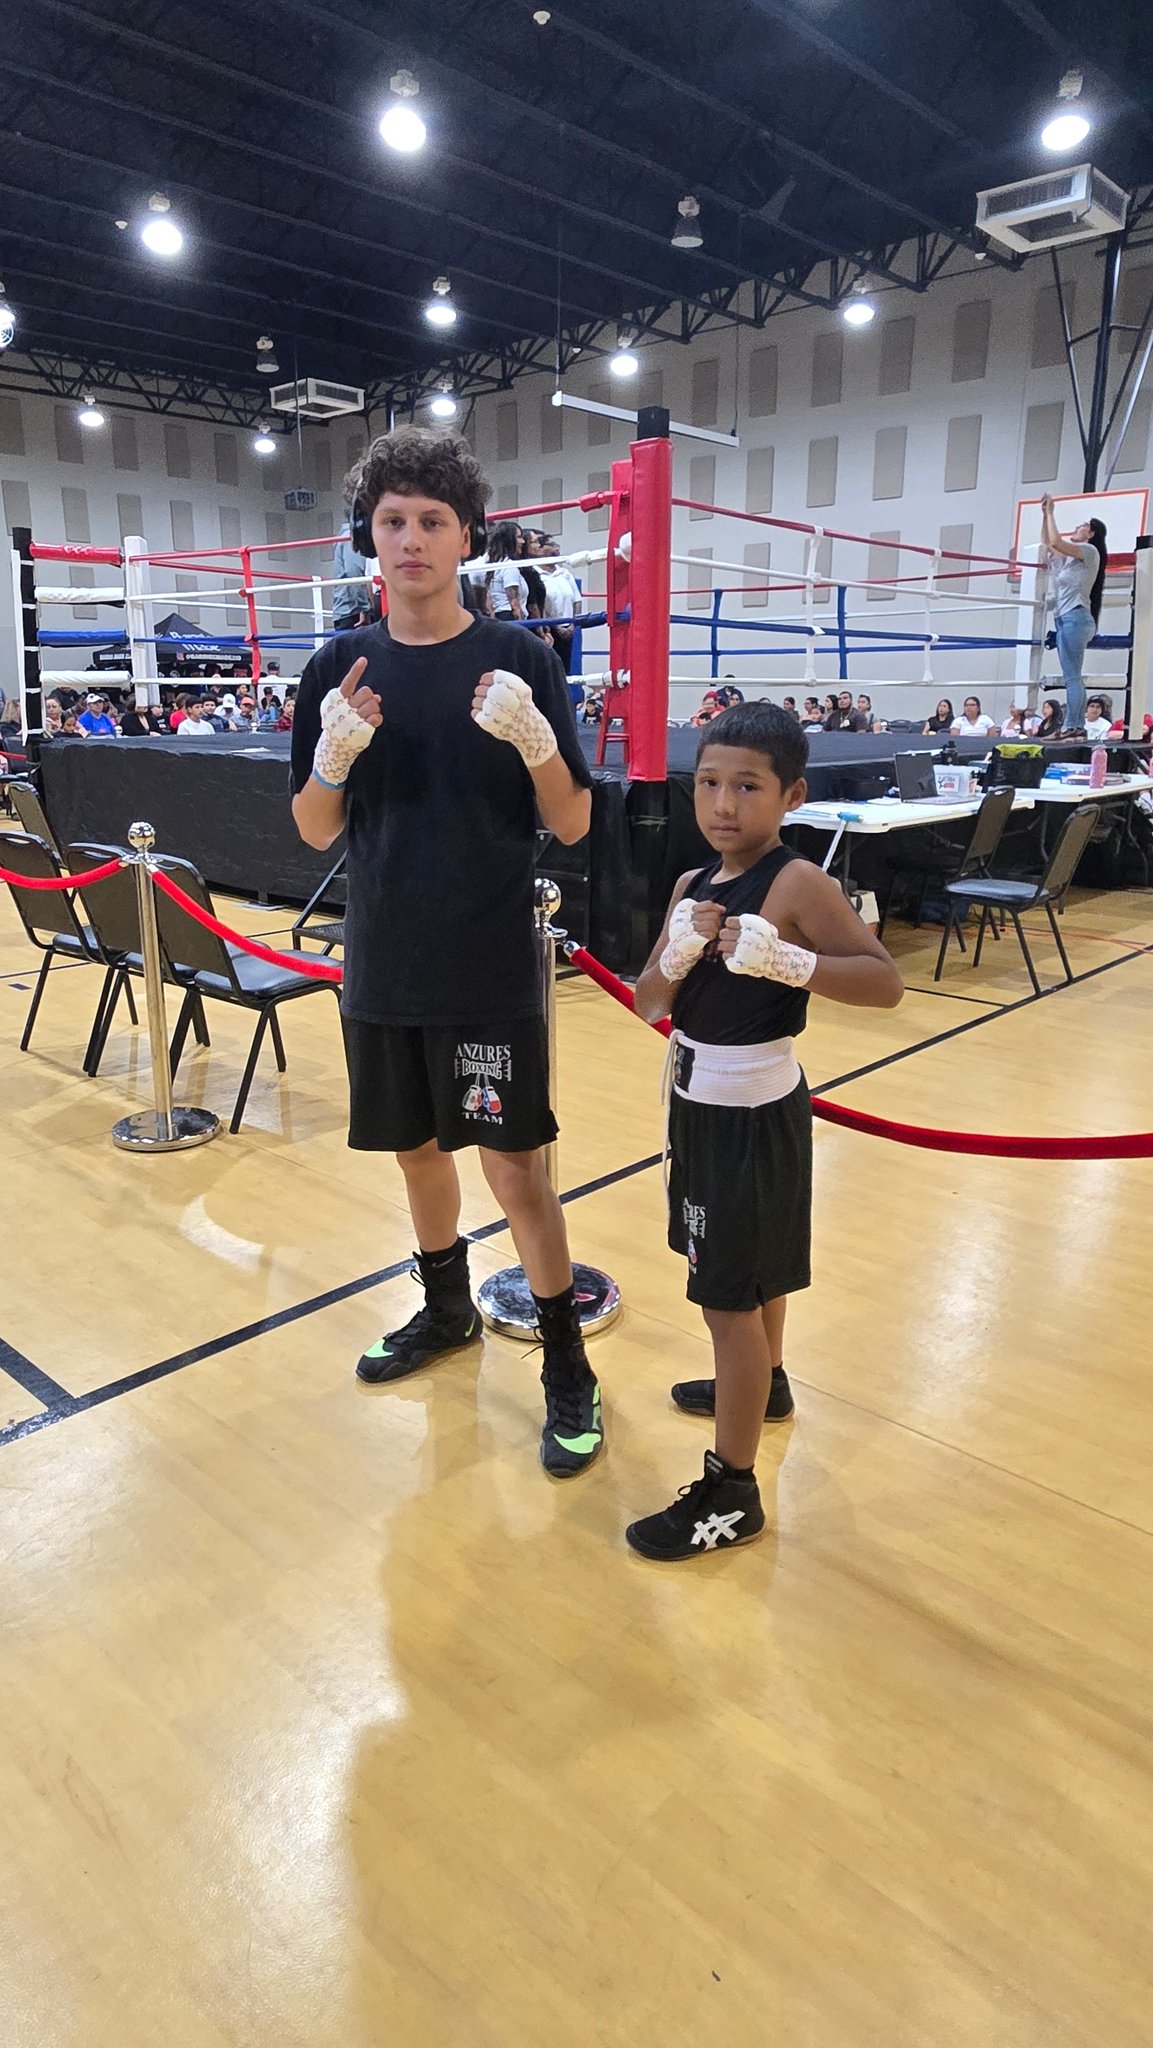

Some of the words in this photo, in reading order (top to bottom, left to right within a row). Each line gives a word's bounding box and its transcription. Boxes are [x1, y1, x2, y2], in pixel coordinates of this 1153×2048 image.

[455, 1043, 511, 1061] ANZURES
[462, 1058, 502, 1080] BOXING
[461, 1112, 503, 1125] TEAM
